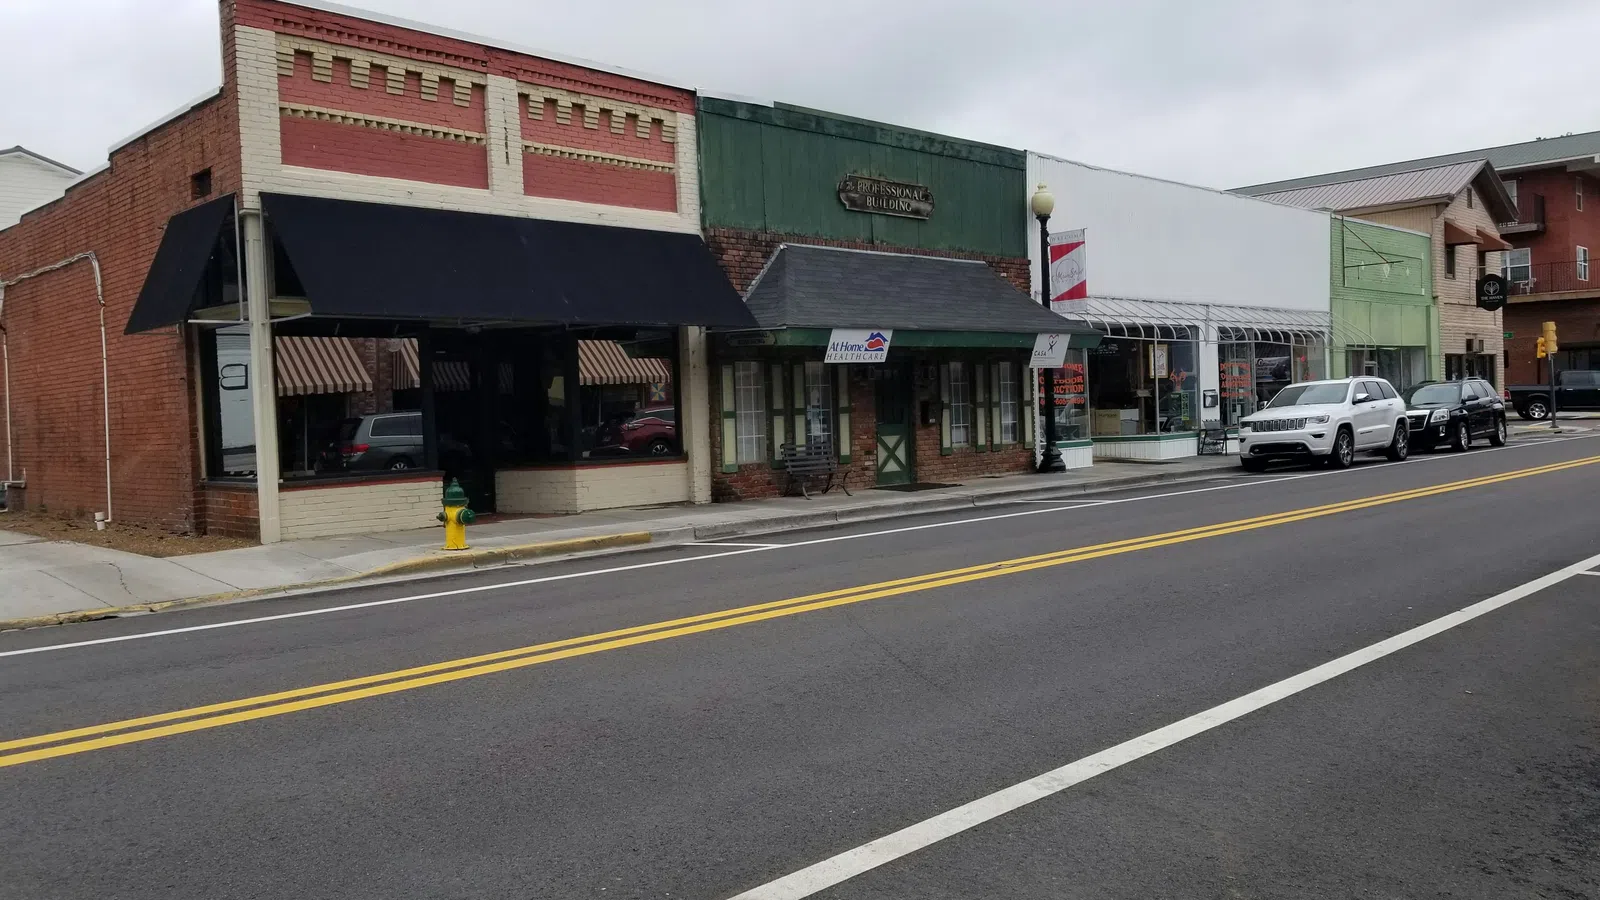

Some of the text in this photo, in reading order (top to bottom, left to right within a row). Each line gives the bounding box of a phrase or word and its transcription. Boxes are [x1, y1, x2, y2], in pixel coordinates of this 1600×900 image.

[857, 181, 926, 201] PROFESSIONAL
[866, 196, 912, 212] BUILDING
[828, 341, 864, 351] At Home
[826, 353, 885, 361] HEALTHCARE
